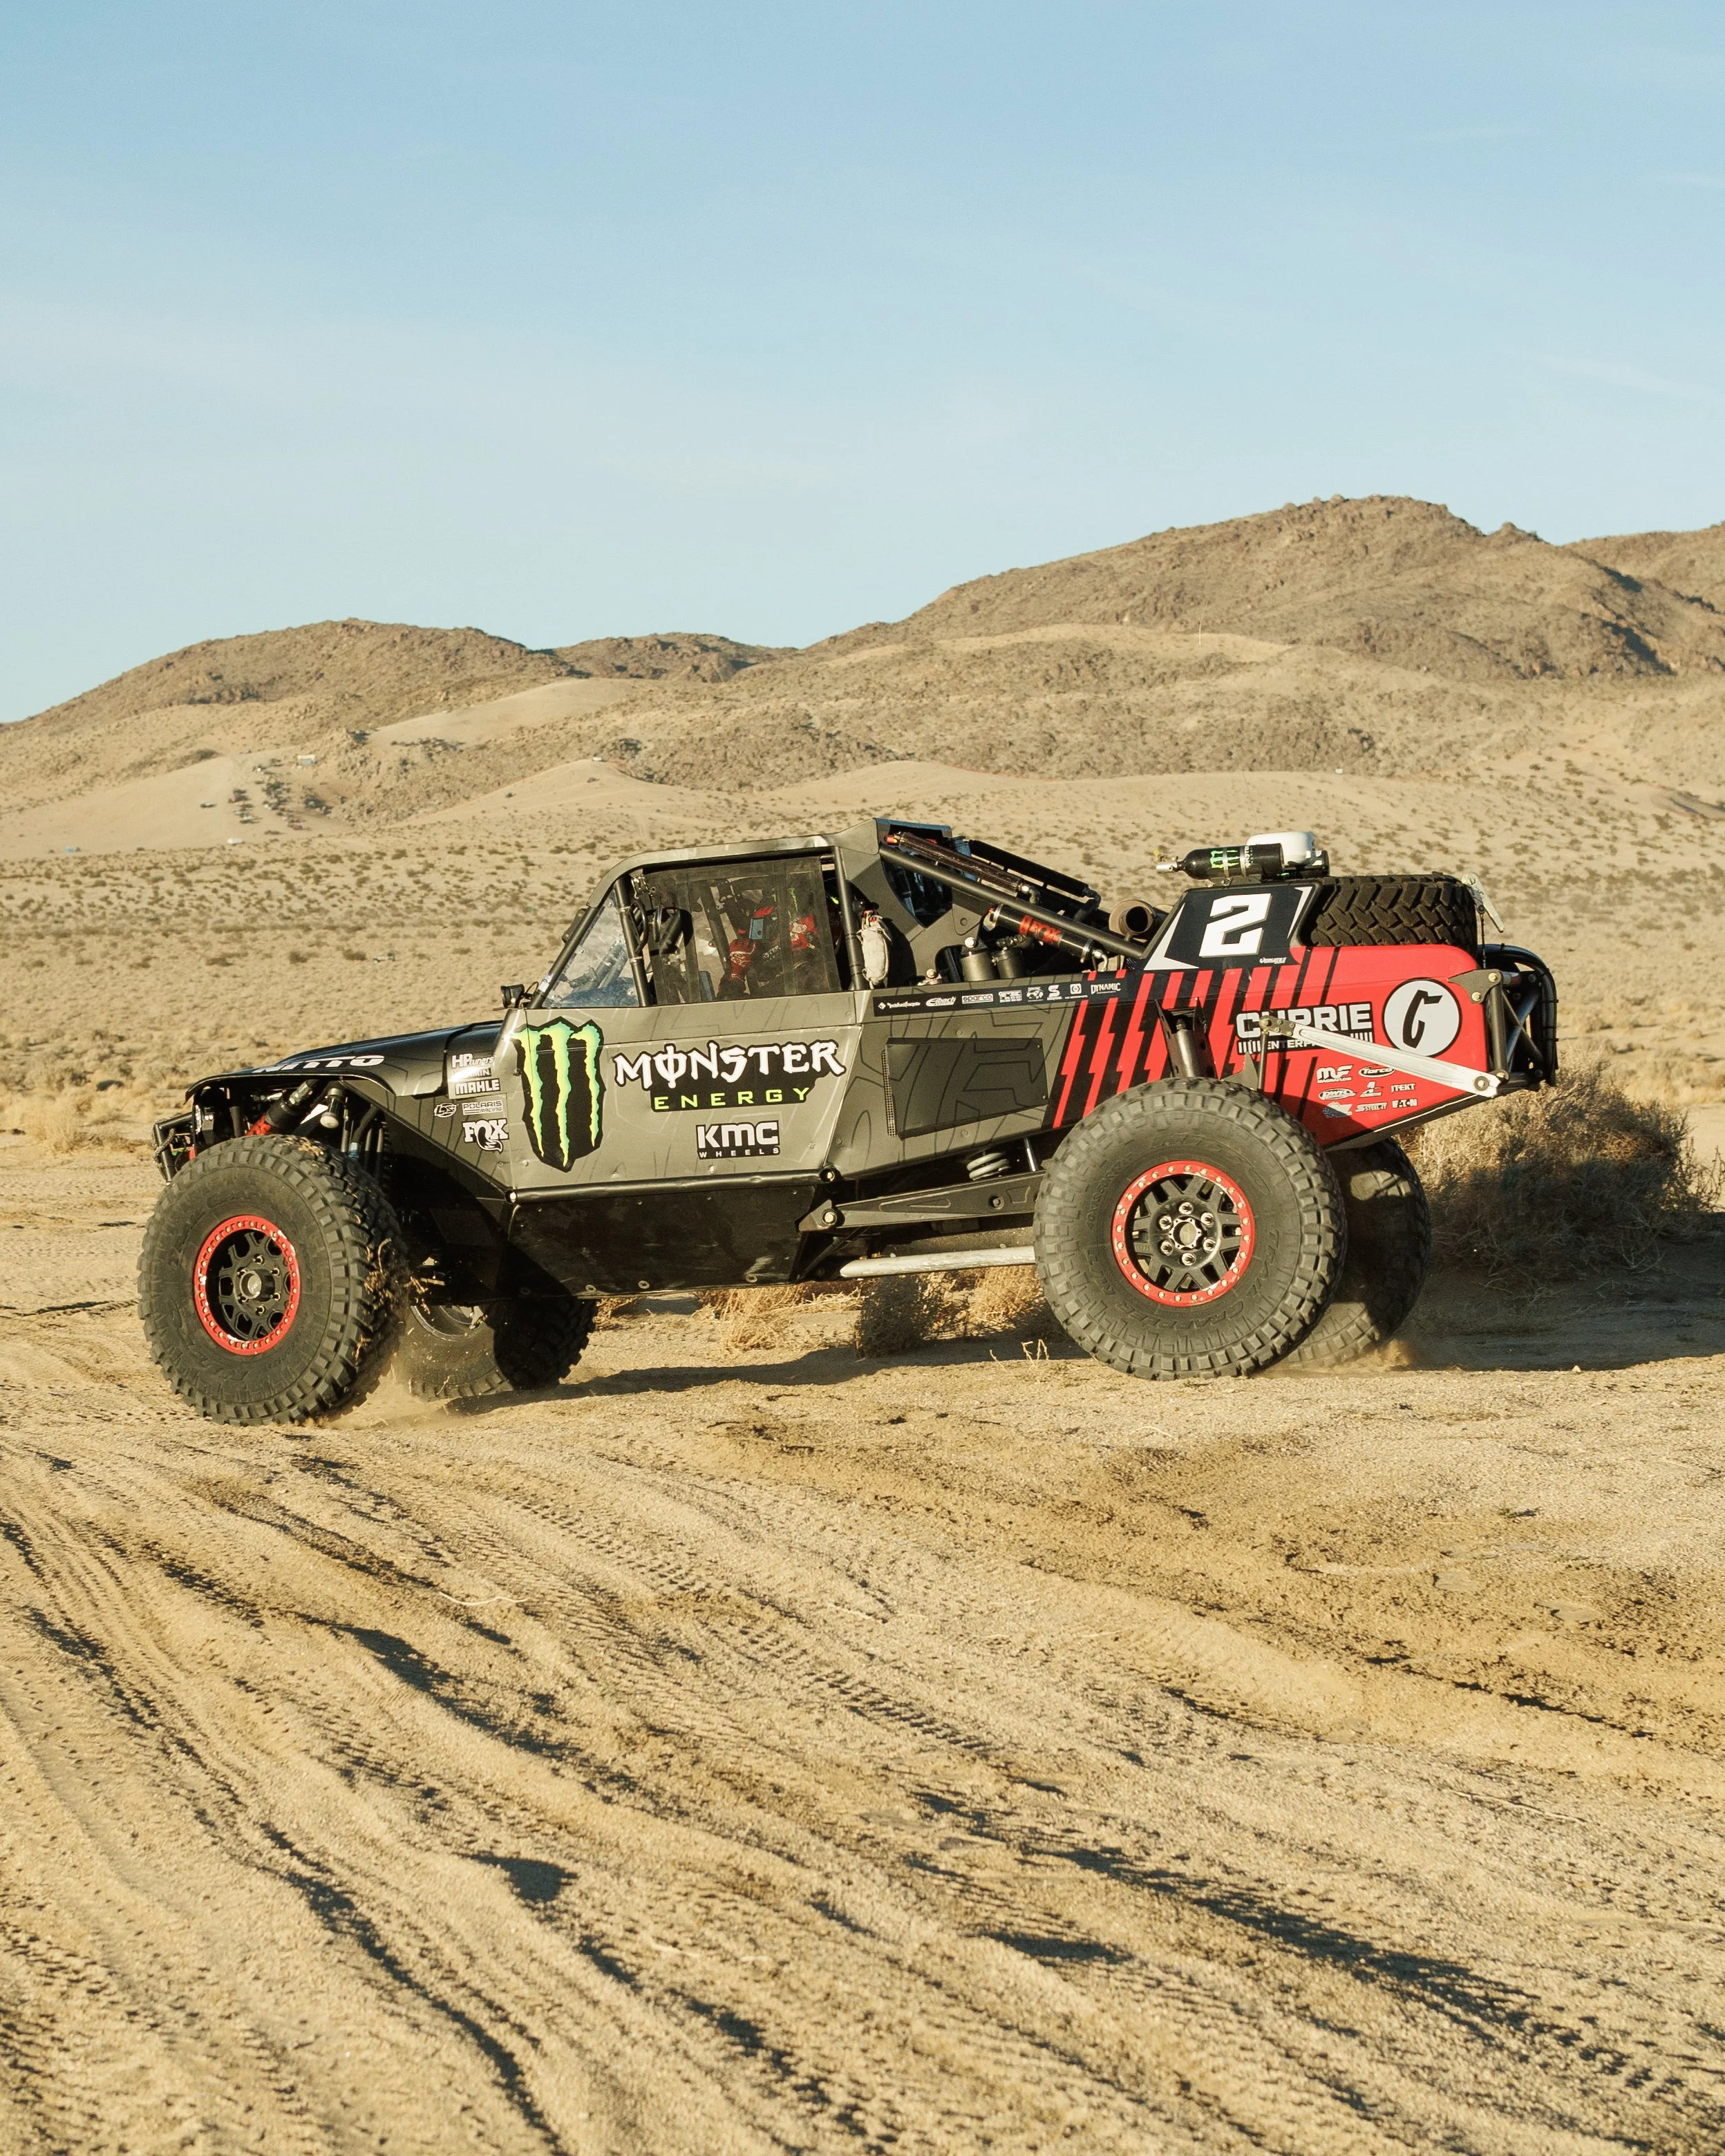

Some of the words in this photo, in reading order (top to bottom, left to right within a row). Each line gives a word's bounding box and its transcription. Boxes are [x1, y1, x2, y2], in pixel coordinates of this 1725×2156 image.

[1199, 893, 1272, 957] 2
[1091, 983, 1121, 994] DYNAMIC
[252, 1055, 384, 1072] NITTO
[614, 1042, 846, 1089] MONSTER
[455, 1079, 500, 1095] MAHLE
[1391, 1084, 1415, 1093] JTEKT
[654, 1088, 810, 1110] ENERGY
[1392, 1099, 1417, 1108] EATON
[462, 1119, 509, 1152] FOX
[697, 1122, 779, 1148] KMC
[699, 1148, 780, 1158] WHEELS
